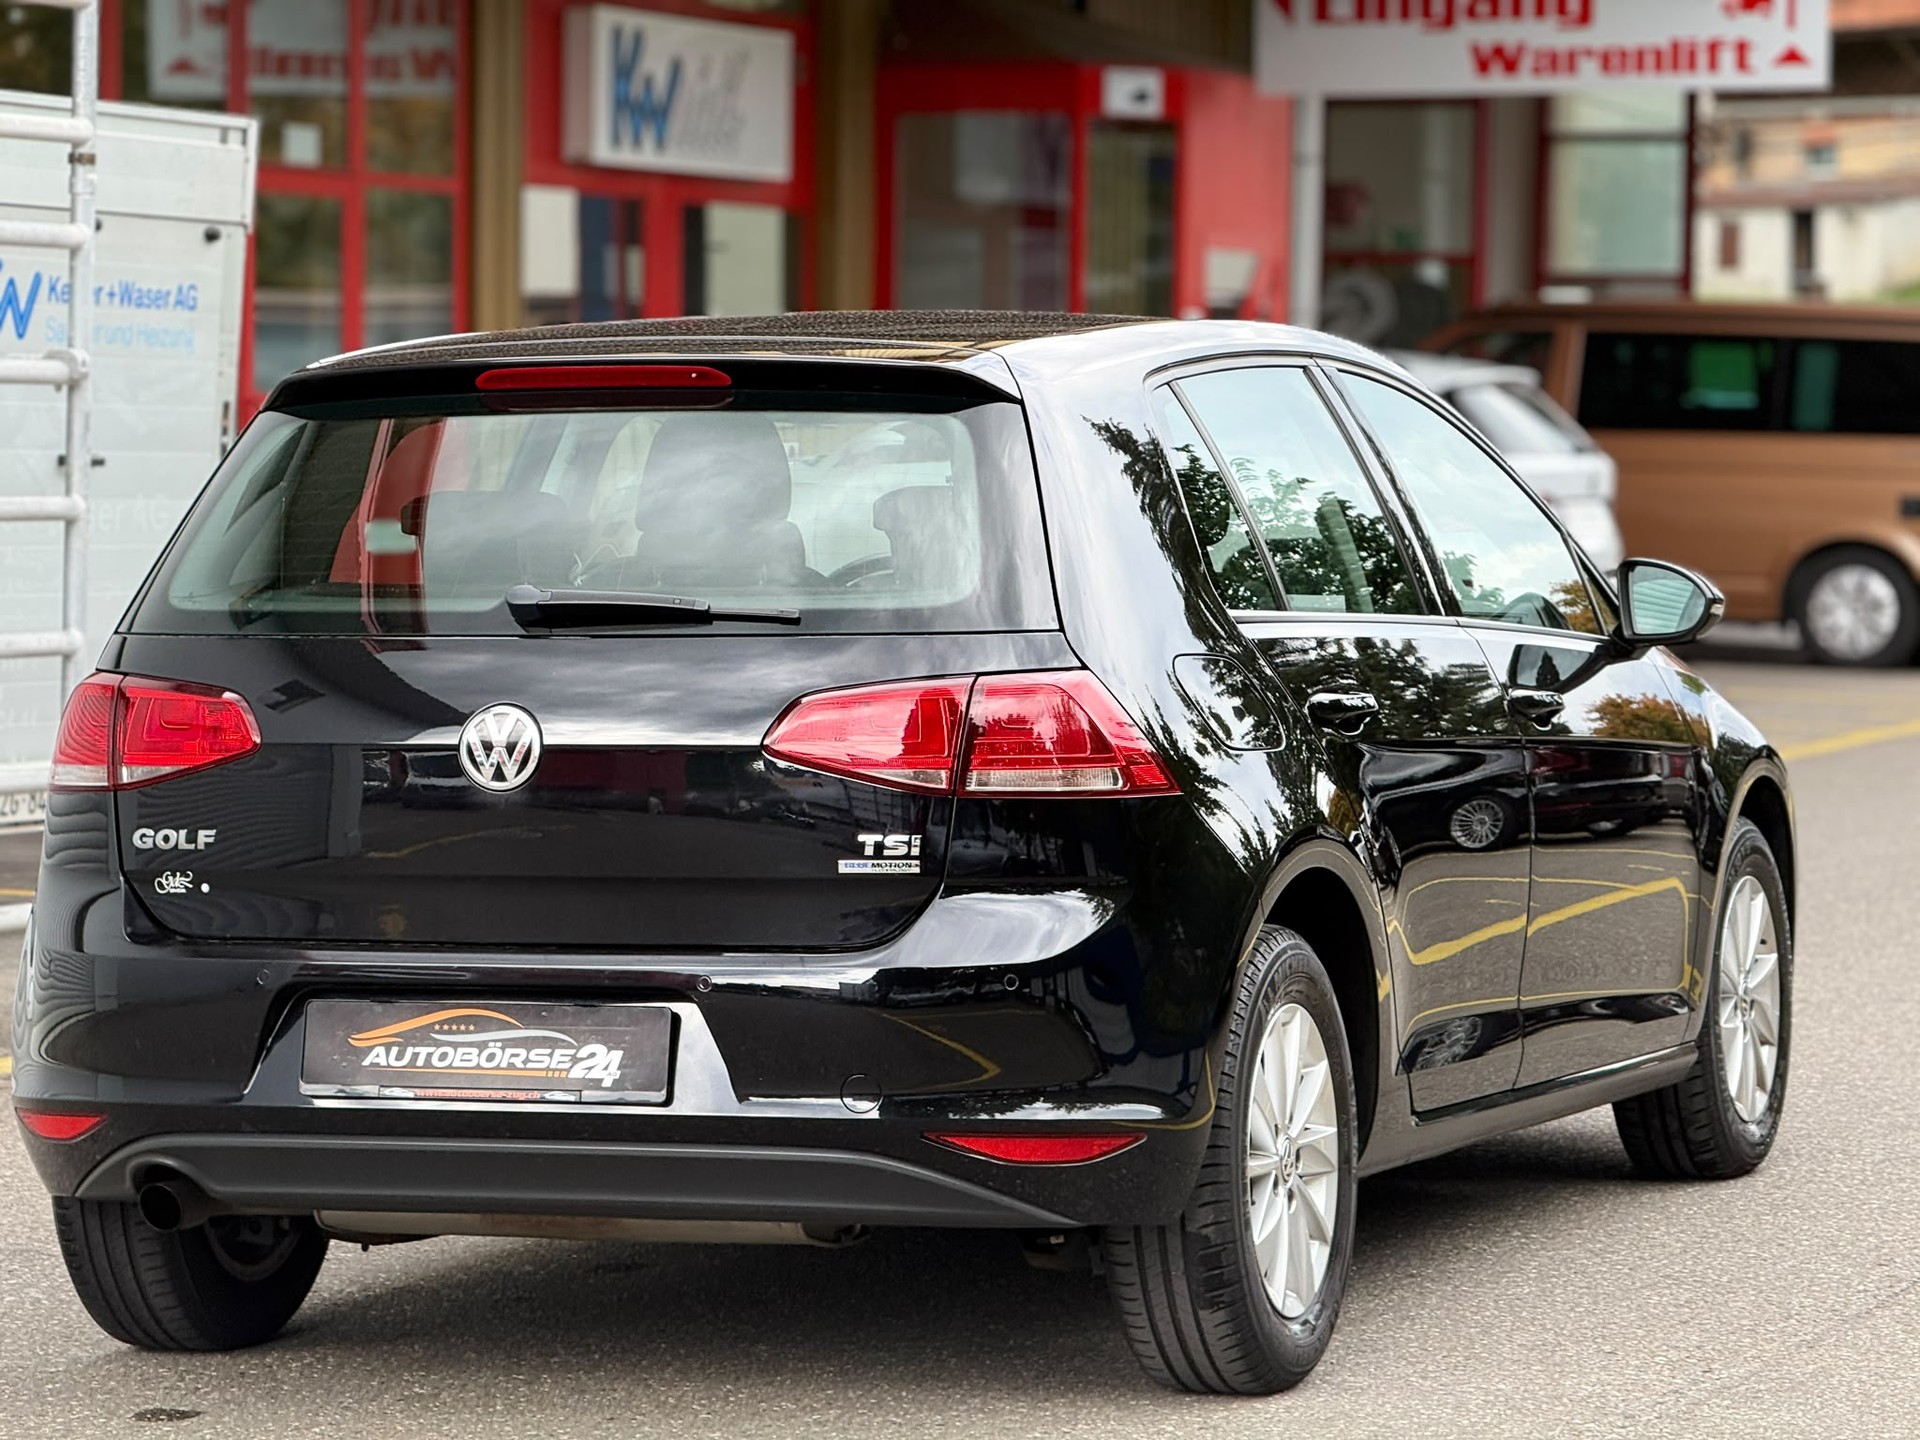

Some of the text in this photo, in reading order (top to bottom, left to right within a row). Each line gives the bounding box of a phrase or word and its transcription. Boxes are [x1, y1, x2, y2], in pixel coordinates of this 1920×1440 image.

[1471, 38, 1754, 75] Warenlift
[173, 284, 197, 311] AG
[132, 828, 217, 850] GOLF
